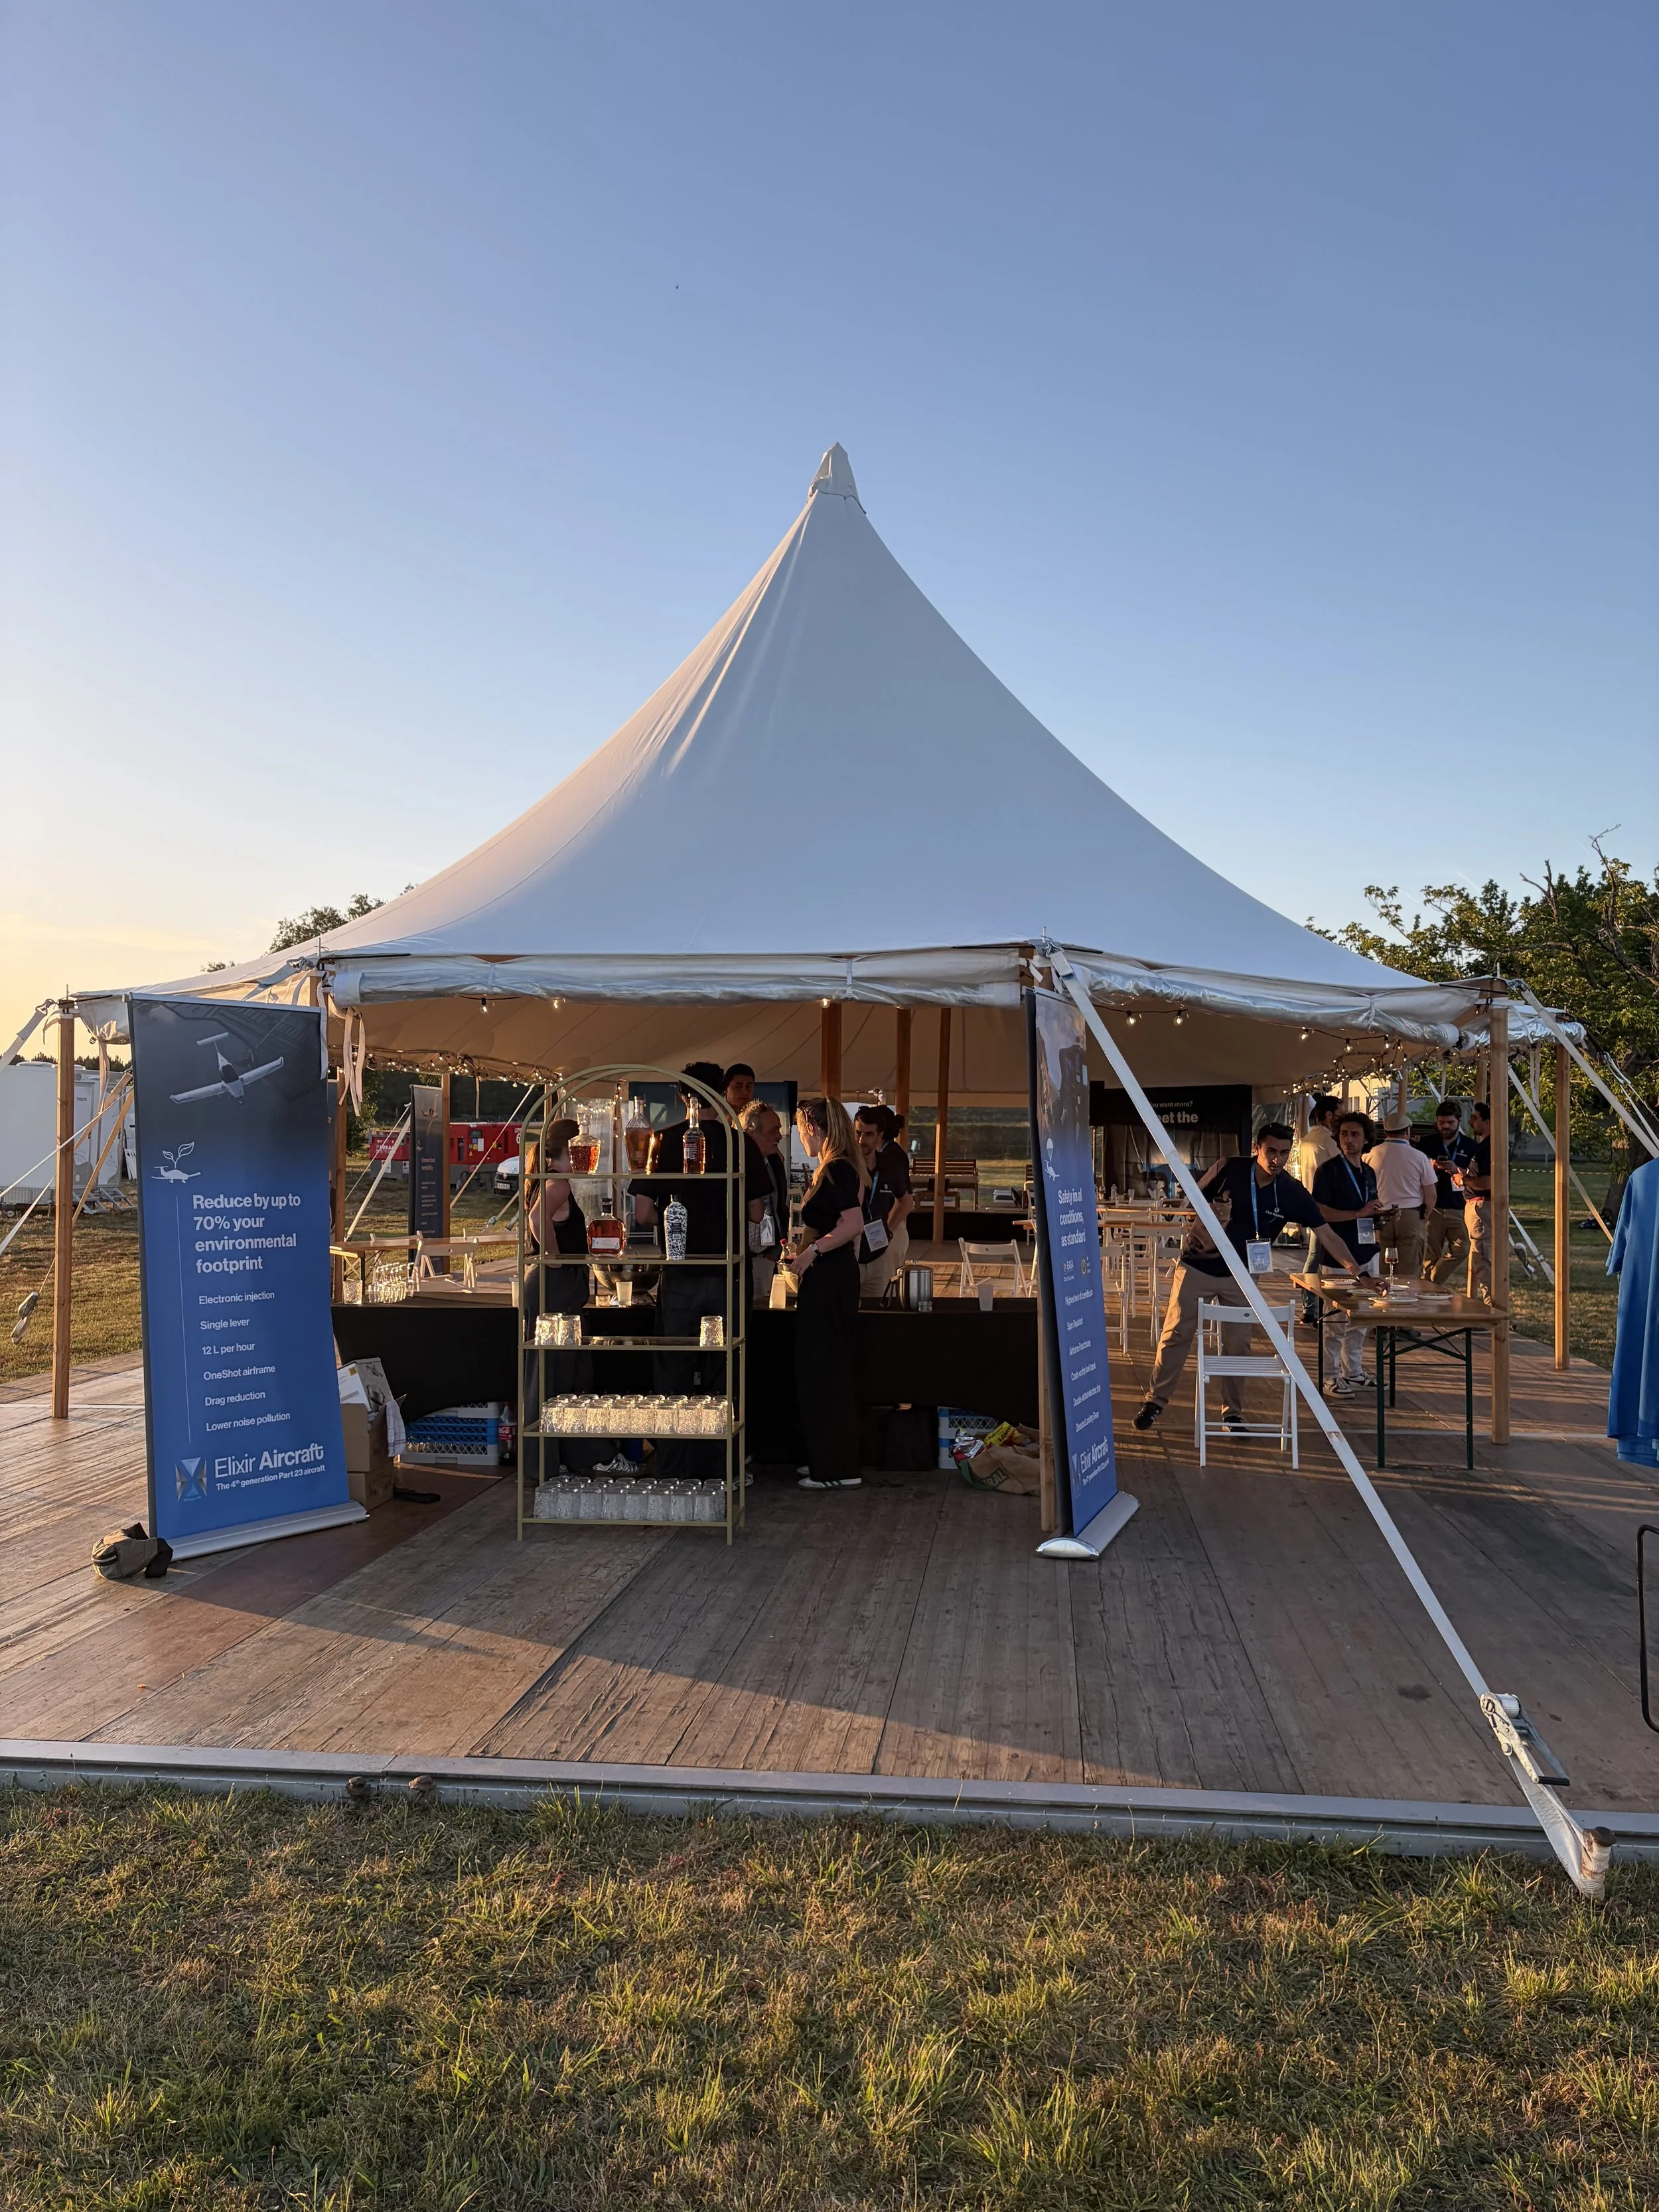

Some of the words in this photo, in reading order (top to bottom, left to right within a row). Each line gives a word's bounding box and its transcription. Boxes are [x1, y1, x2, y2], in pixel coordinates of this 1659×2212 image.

[1177, 1110, 1198, 1124] the
[193, 1195, 252, 1209] Reduce
[254, 1193, 269, 1209] by
[271, 1197, 287, 1209] up
[288, 1194, 301, 1206] to
[1058, 1189, 1072, 1205] Safety
[194, 1216, 230, 1230] 70%
[233, 1218, 265, 1231] your
[195, 1233, 296, 1252] environmental
[1060, 1235, 1067, 1246] as
[196, 1256, 262, 1274] footprint
[199, 1293, 243, 1304] Electronic
[245, 1291, 274, 1301] injection
[200, 1320, 228, 1330] Single
[221, 1346, 235, 1355] per
[204, 1368, 242, 1380] OneShot
[243, 1366, 275, 1376] airframe
[205, 1397, 225, 1406] Drag
[227, 1391, 265, 1403] reduction
[206, 1422, 232, 1431] Lower
[234, 1418, 255, 1427] noise
[257, 1412, 290, 1426] pollution
[215, 1454, 256, 1479] Elixir
[259, 1443, 325, 1471] Aircraft
[242, 1474, 278, 1487] generation
[279, 1471, 294, 1479] Part
[304, 1465, 325, 1475] aircraft
